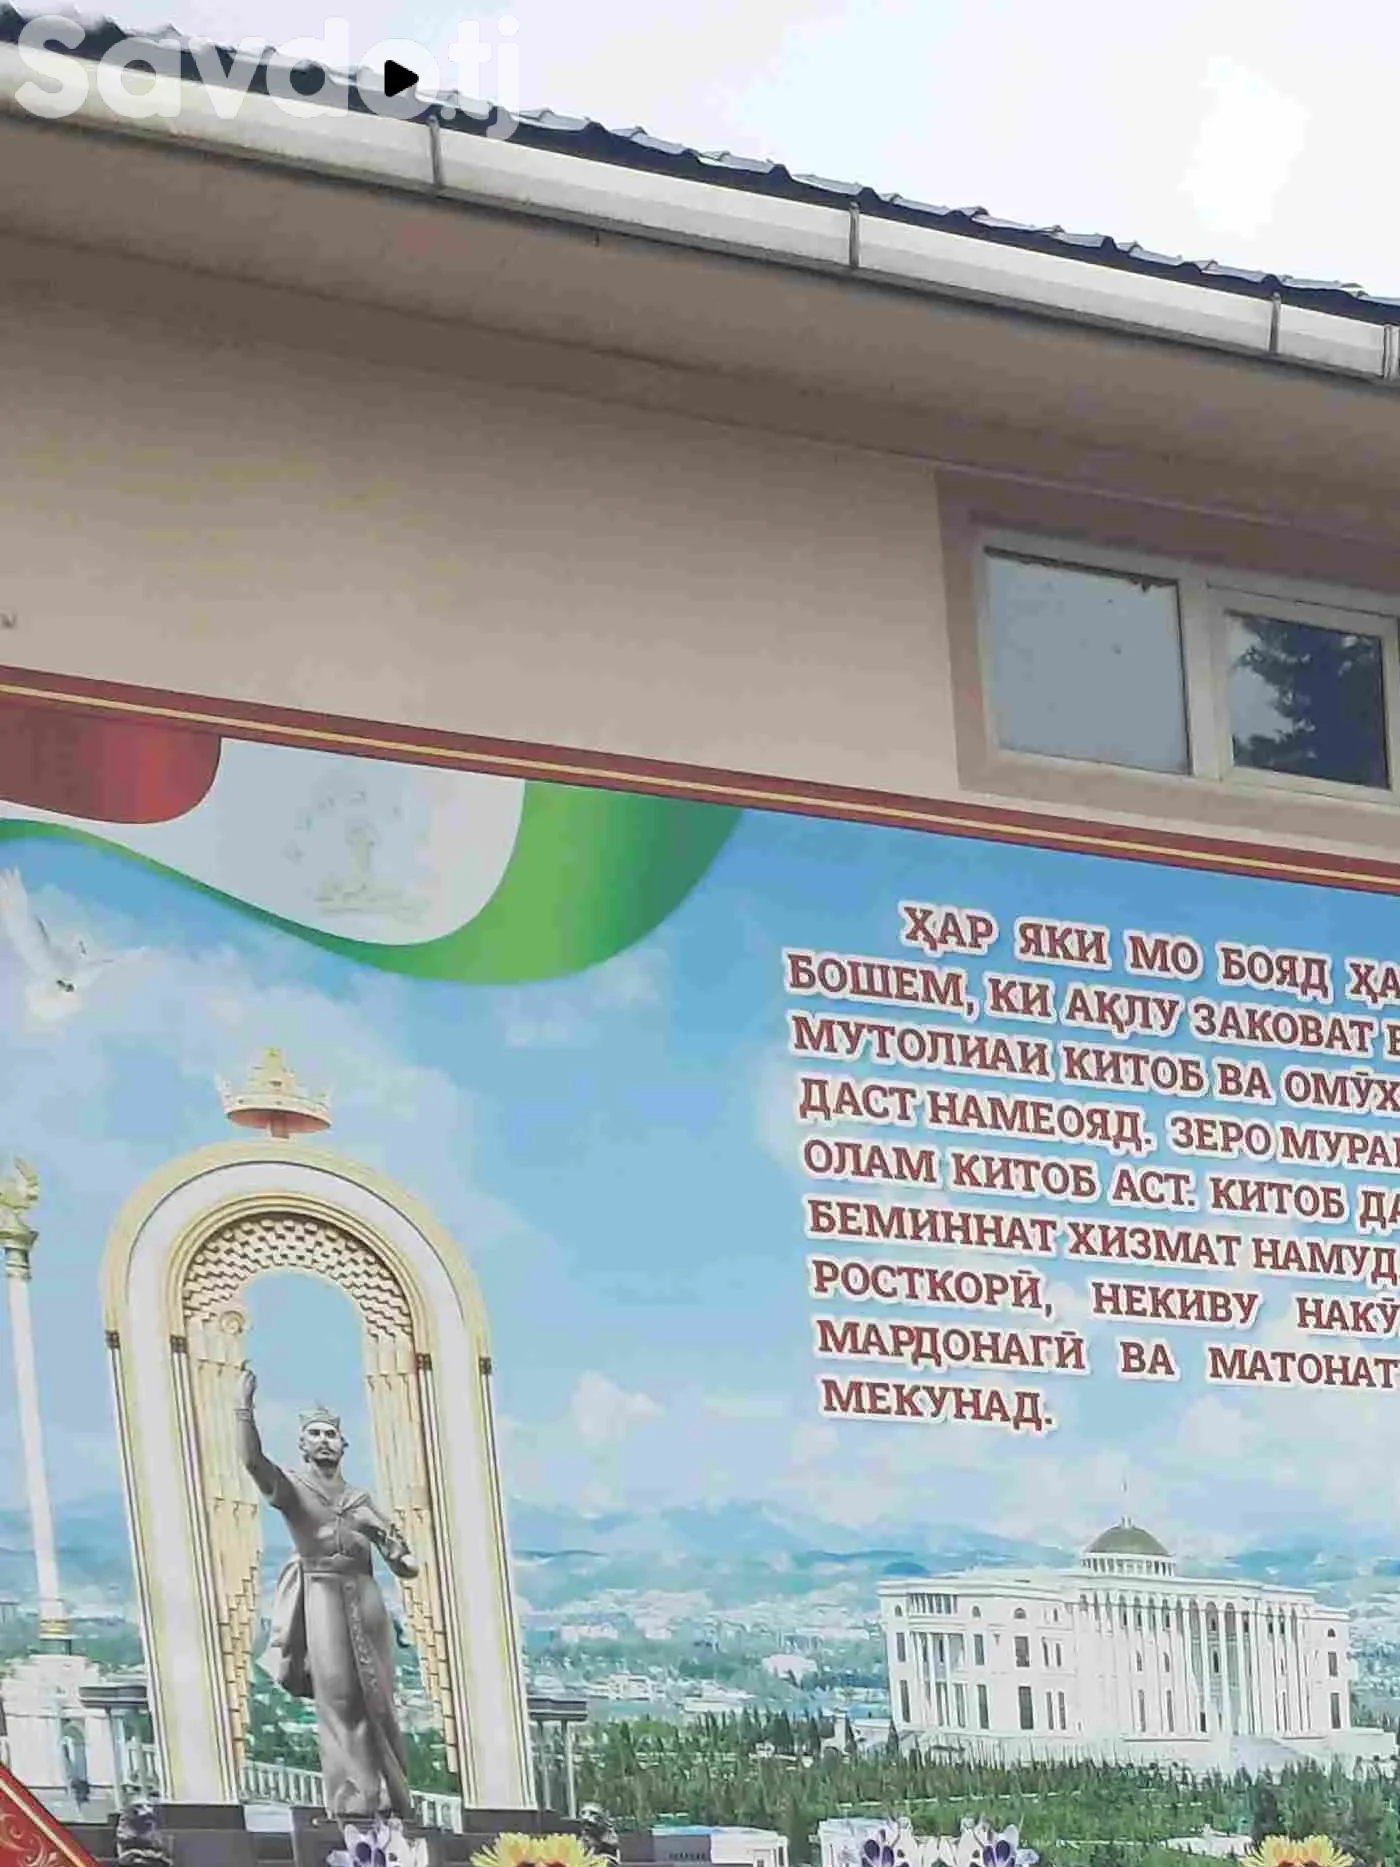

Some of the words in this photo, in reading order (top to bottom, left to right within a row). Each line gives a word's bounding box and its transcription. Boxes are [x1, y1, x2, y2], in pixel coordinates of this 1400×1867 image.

[904, 906, 994, 952] ҲАР
[1020, 922, 1107, 965] ЯКИ
[1128, 935, 1199, 975] МО
[1220, 946, 1329, 999] БОЯД
[789, 954, 974, 1014] БОШЕМ,
[988, 977, 1050, 1017] КИ
[1068, 988, 1180, 1034] АҚЛУ
[1193, 1003, 1374, 1053] ЗАКОВАТ
[792, 1015, 1050, 1077] МУТОЛИАИ
[1063, 1047, 1204, 1092] КИТОБ
[1218, 1064, 1272, 1099] ВА
[799, 1077, 915, 1122] ДАСТ
[929, 1090, 1149, 1153] НАМЕОЯД.
[1173, 1117, 1272, 1155] ЗЕРО
[803, 1139, 937, 1183] ОЛАМ
[952, 1152, 1097, 1197] КИТОБ
[1112, 1169, 1195, 1206] АСТ.
[1211, 1177, 1345, 1219] КИТОБ
[809, 1199, 1057, 1252] БЕМИННАТ
[1068, 1222, 1239, 1266] ХИЗМАТ
[812, 1259, 1052, 1316] РОСТКОРӢ,
[1092, 1281, 1259, 1324] НЕКИВУ
[816, 1319, 1086, 1370] МАРДОНАГӢ
[1121, 1341, 1175, 1376] ВА
[821, 1378, 1052, 1432] МЕКУНАД.
